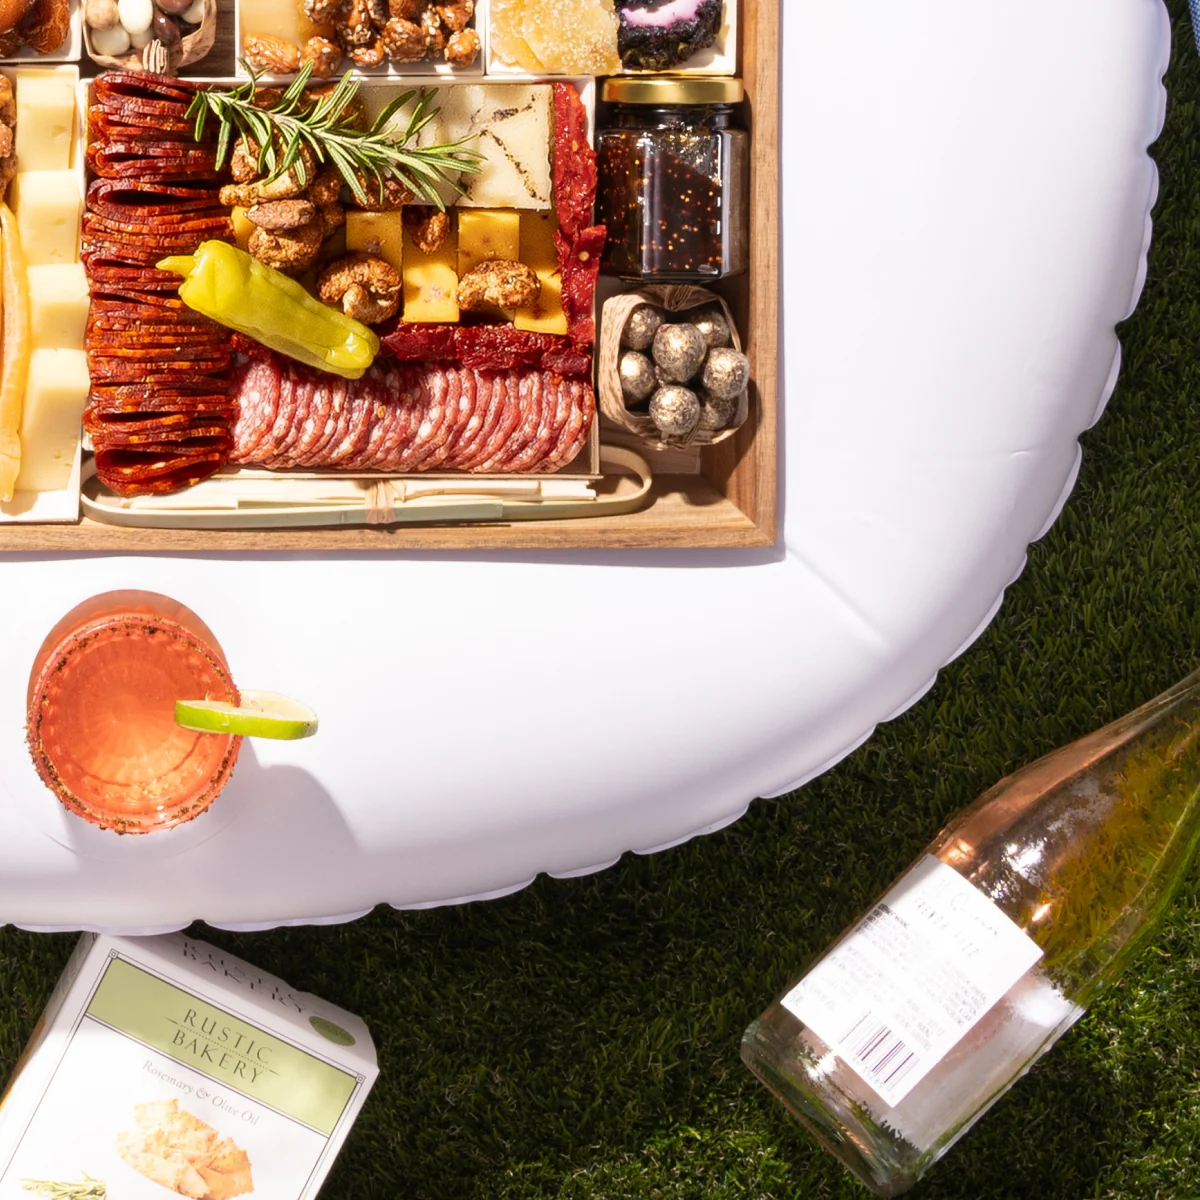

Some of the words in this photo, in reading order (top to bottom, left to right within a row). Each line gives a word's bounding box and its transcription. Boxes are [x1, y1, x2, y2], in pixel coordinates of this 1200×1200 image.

[172, 1029, 263, 1084] BAKERY
[183, 1009, 273, 1064] RUSTIC
[142, 1060, 194, 1096] Rosemary
[195, 1087, 211, 1100] &
[211, 1095, 239, 1116] Olive
[241, 1109, 260, 1126] Oil
